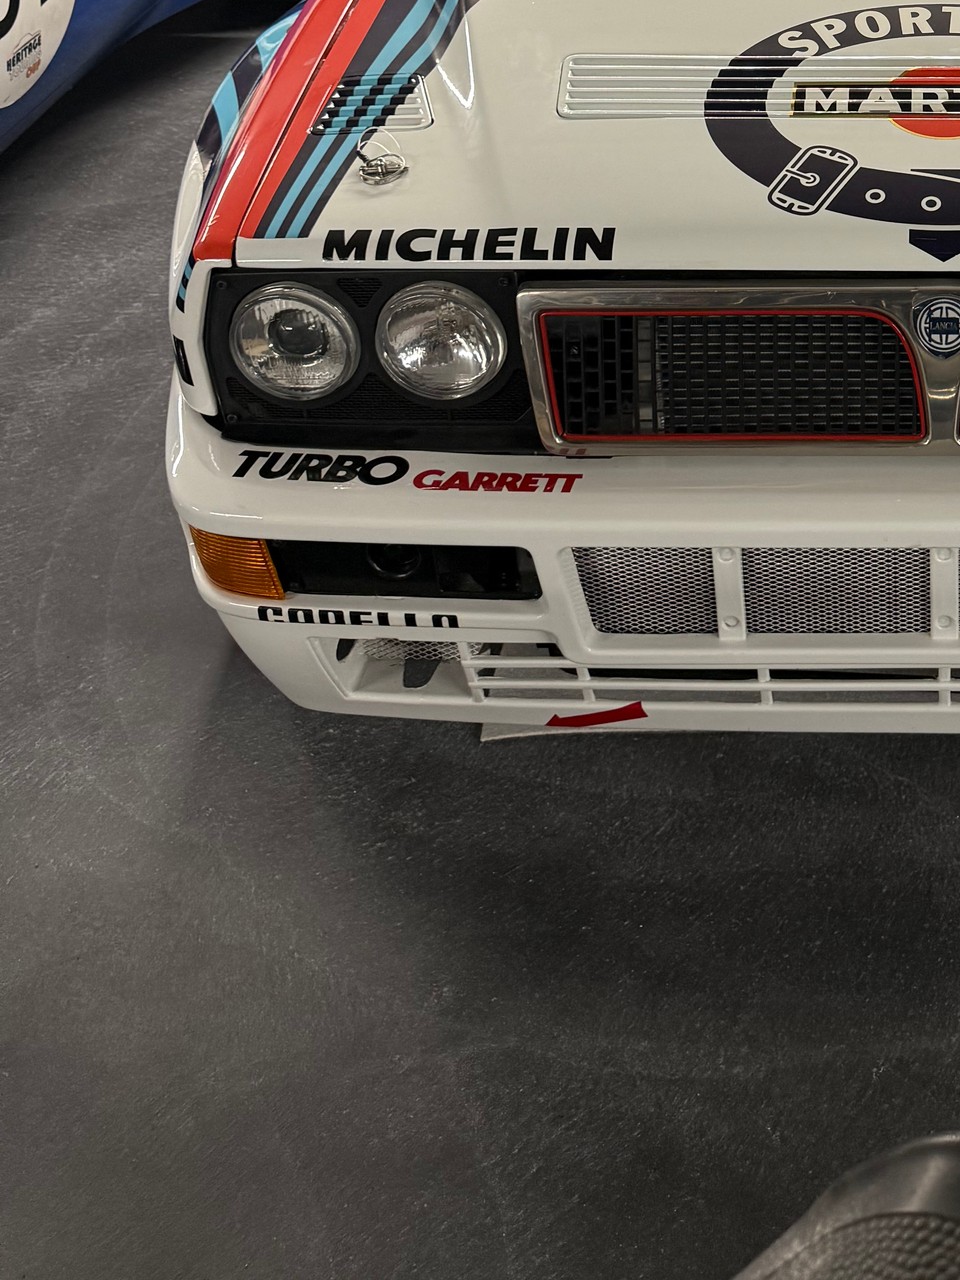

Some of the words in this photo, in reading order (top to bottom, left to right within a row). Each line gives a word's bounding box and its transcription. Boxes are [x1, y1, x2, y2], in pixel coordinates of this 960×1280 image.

[322, 227, 616, 262] MICHELIN
[929, 321, 959, 330] LANCIA
[232, 449, 410, 485] TURBO
[412, 469, 584, 493] GARRETT
